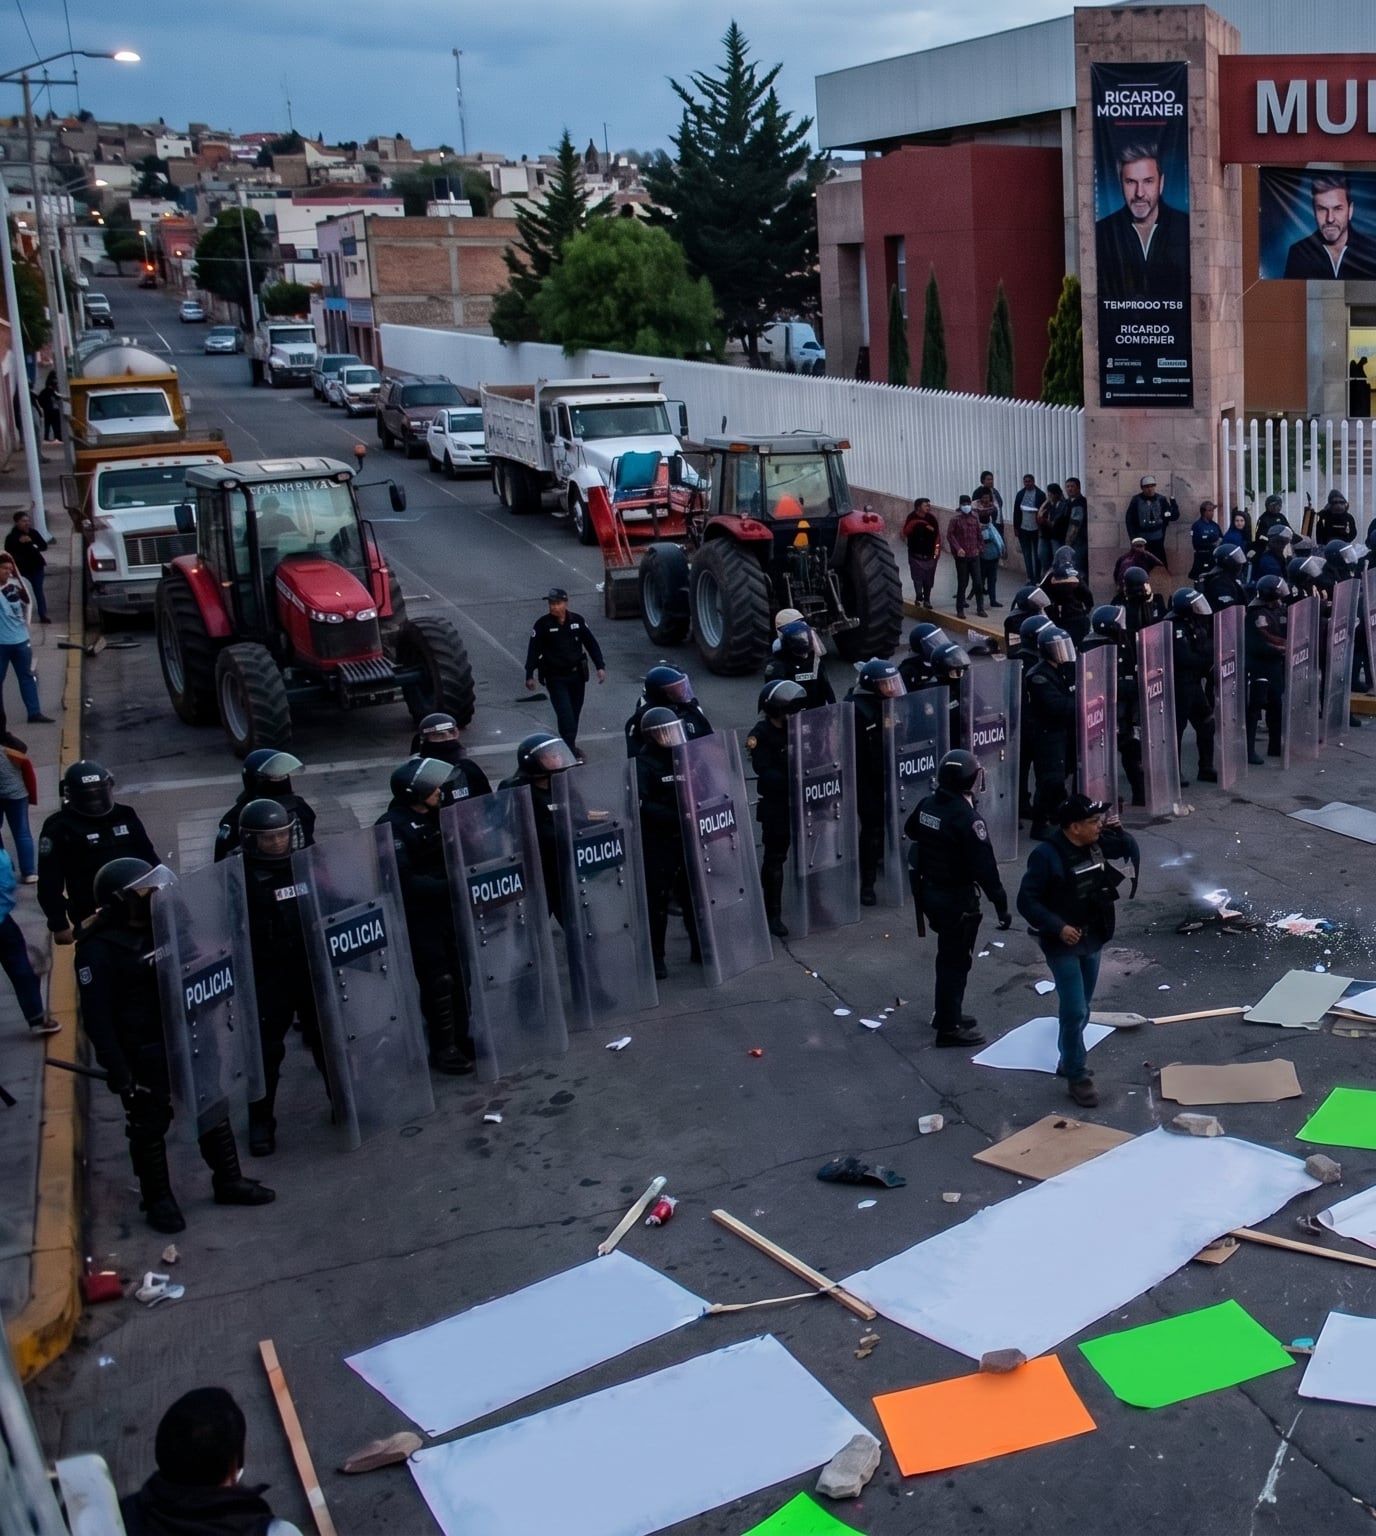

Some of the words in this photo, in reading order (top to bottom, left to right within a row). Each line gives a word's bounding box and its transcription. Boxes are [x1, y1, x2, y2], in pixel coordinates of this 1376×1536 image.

[1105, 90, 1176, 103] RICARDO
[1097, 104, 1184, 117] MONTANER
[1120, 325, 1170, 334] RICARDO
[973, 727, 1005, 746] POLICIA
[899, 755, 935, 778] POLICIA
[805, 779, 841, 803] POLICIA
[699, 809, 735, 836] POLICIA
[576, 839, 623, 867] POLICIA
[471, 873, 523, 905] POLICIA
[330, 919, 385, 957] POLICIA
[186, 967, 233, 1010] POLICIA
